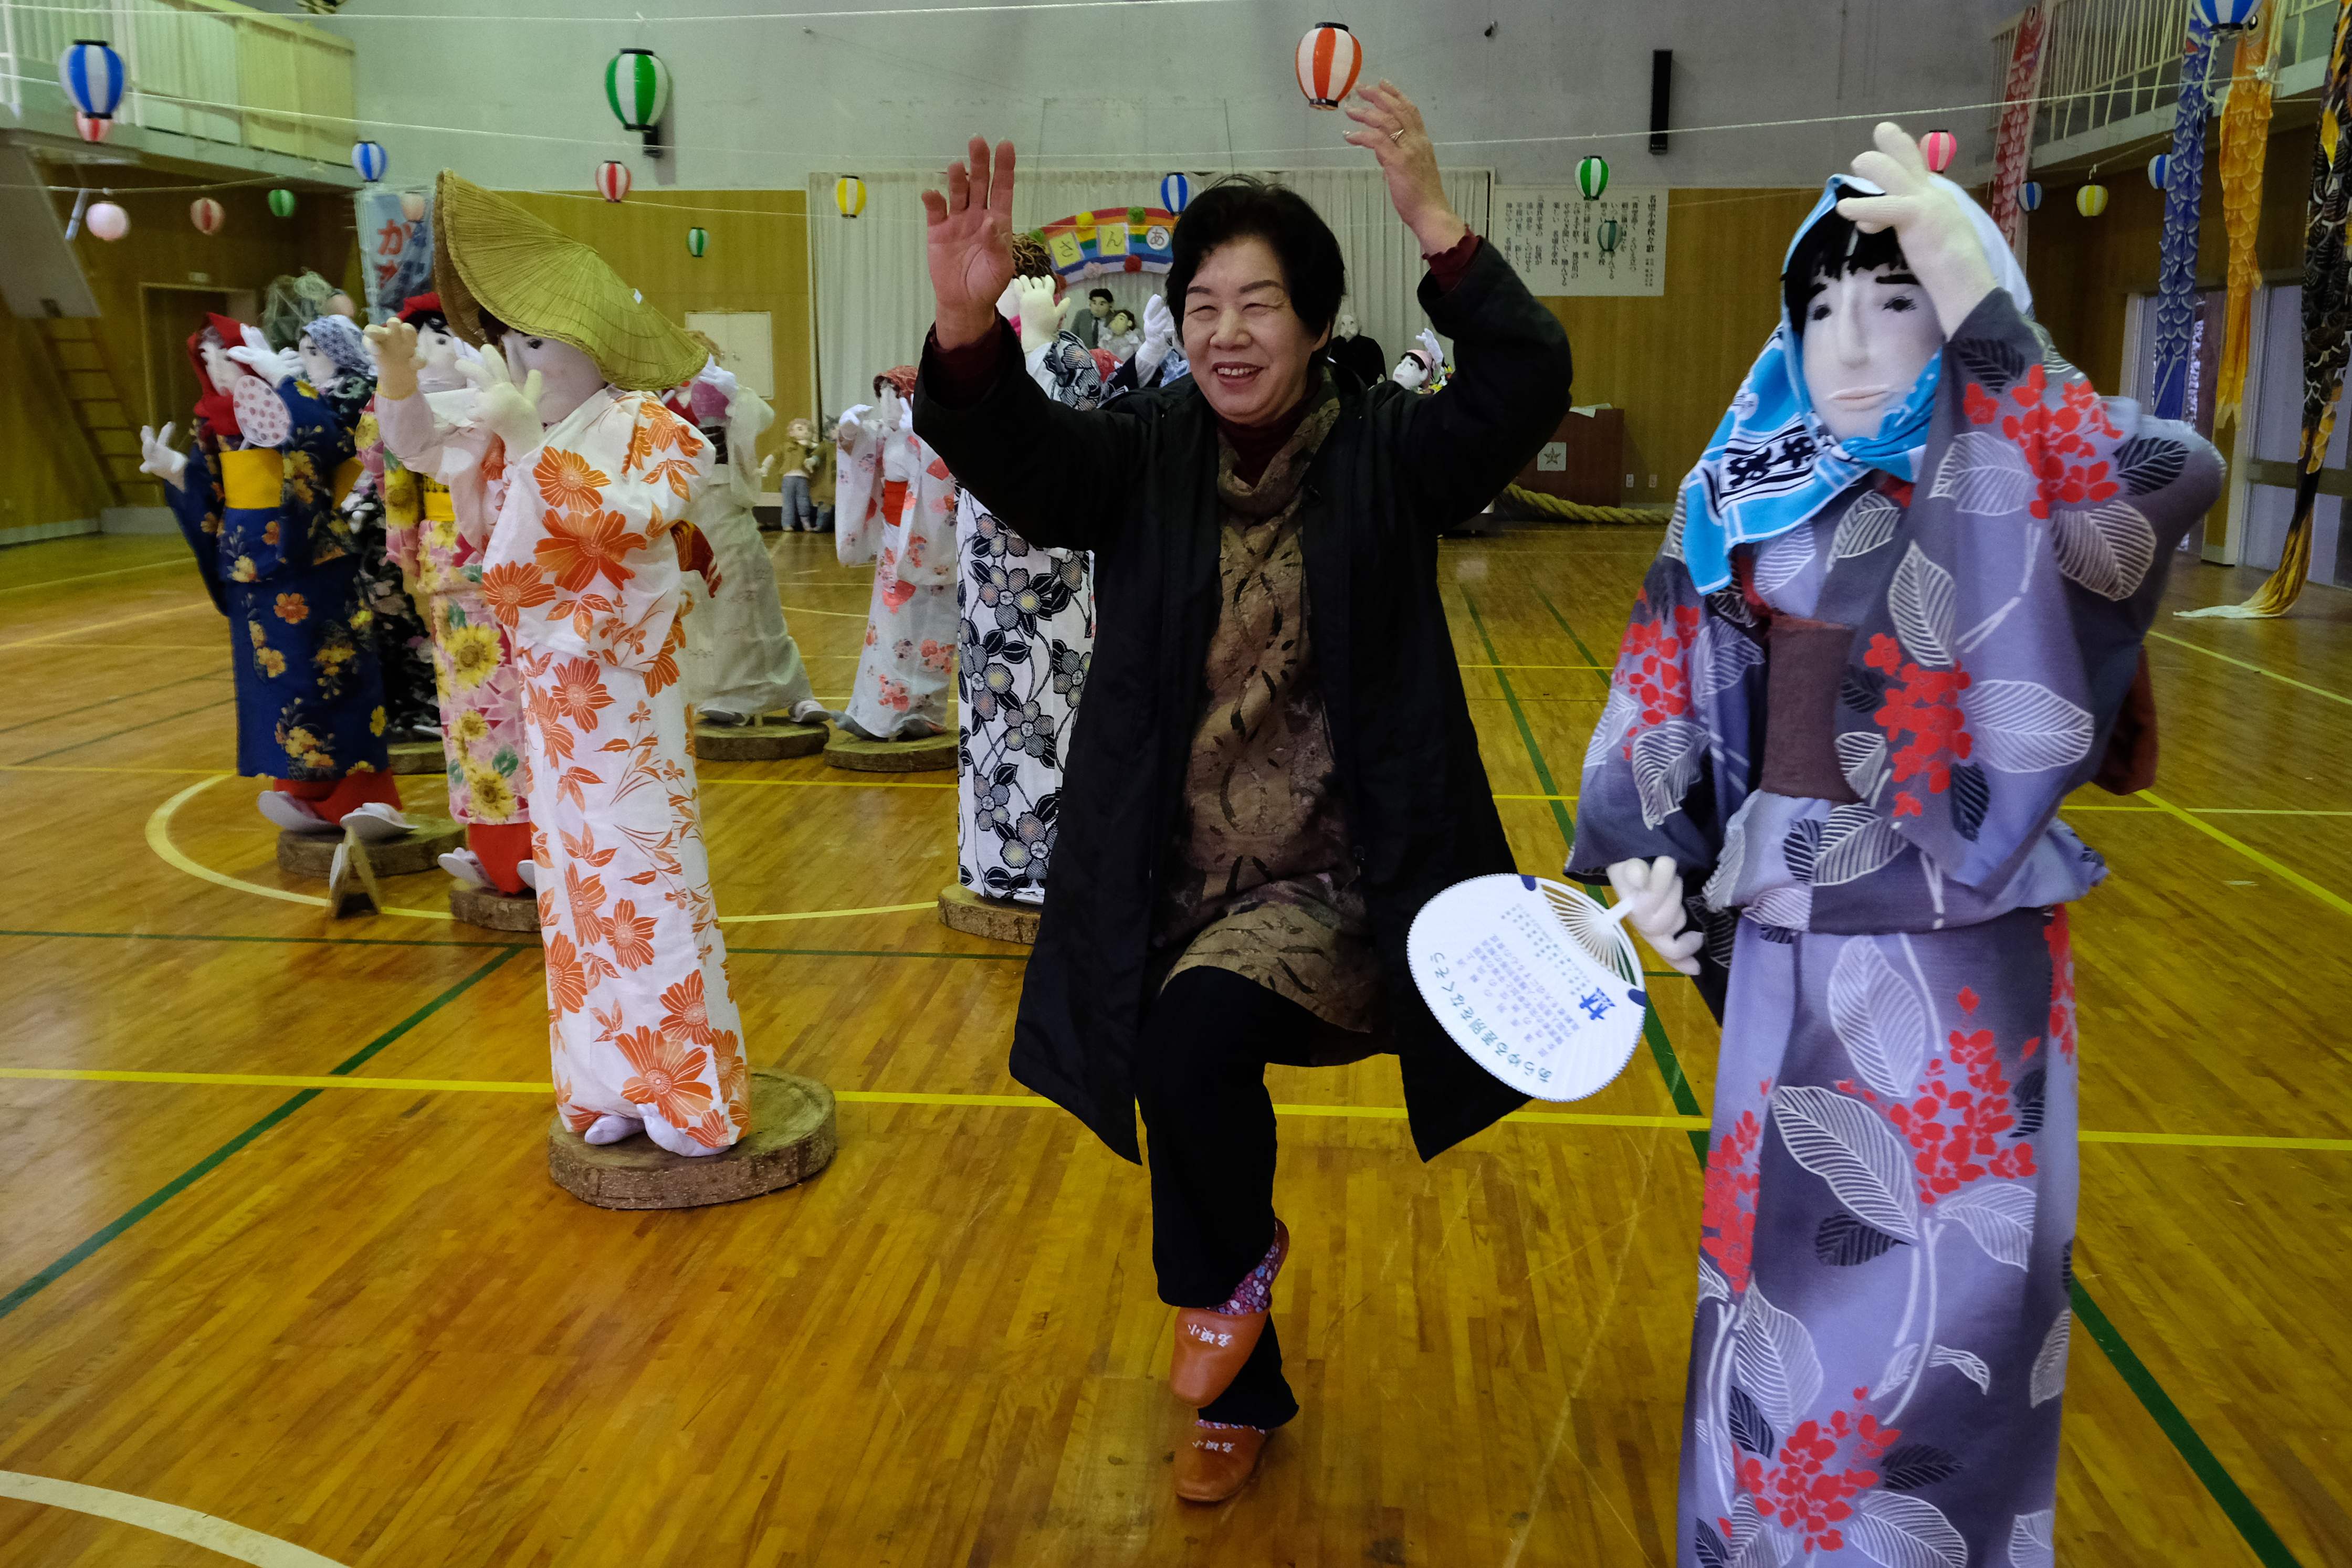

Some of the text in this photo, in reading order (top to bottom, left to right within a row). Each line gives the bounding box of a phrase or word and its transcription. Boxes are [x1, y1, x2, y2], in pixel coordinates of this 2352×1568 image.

[1430, 952, 1552, 1083] あらゆる差別をなくそう
